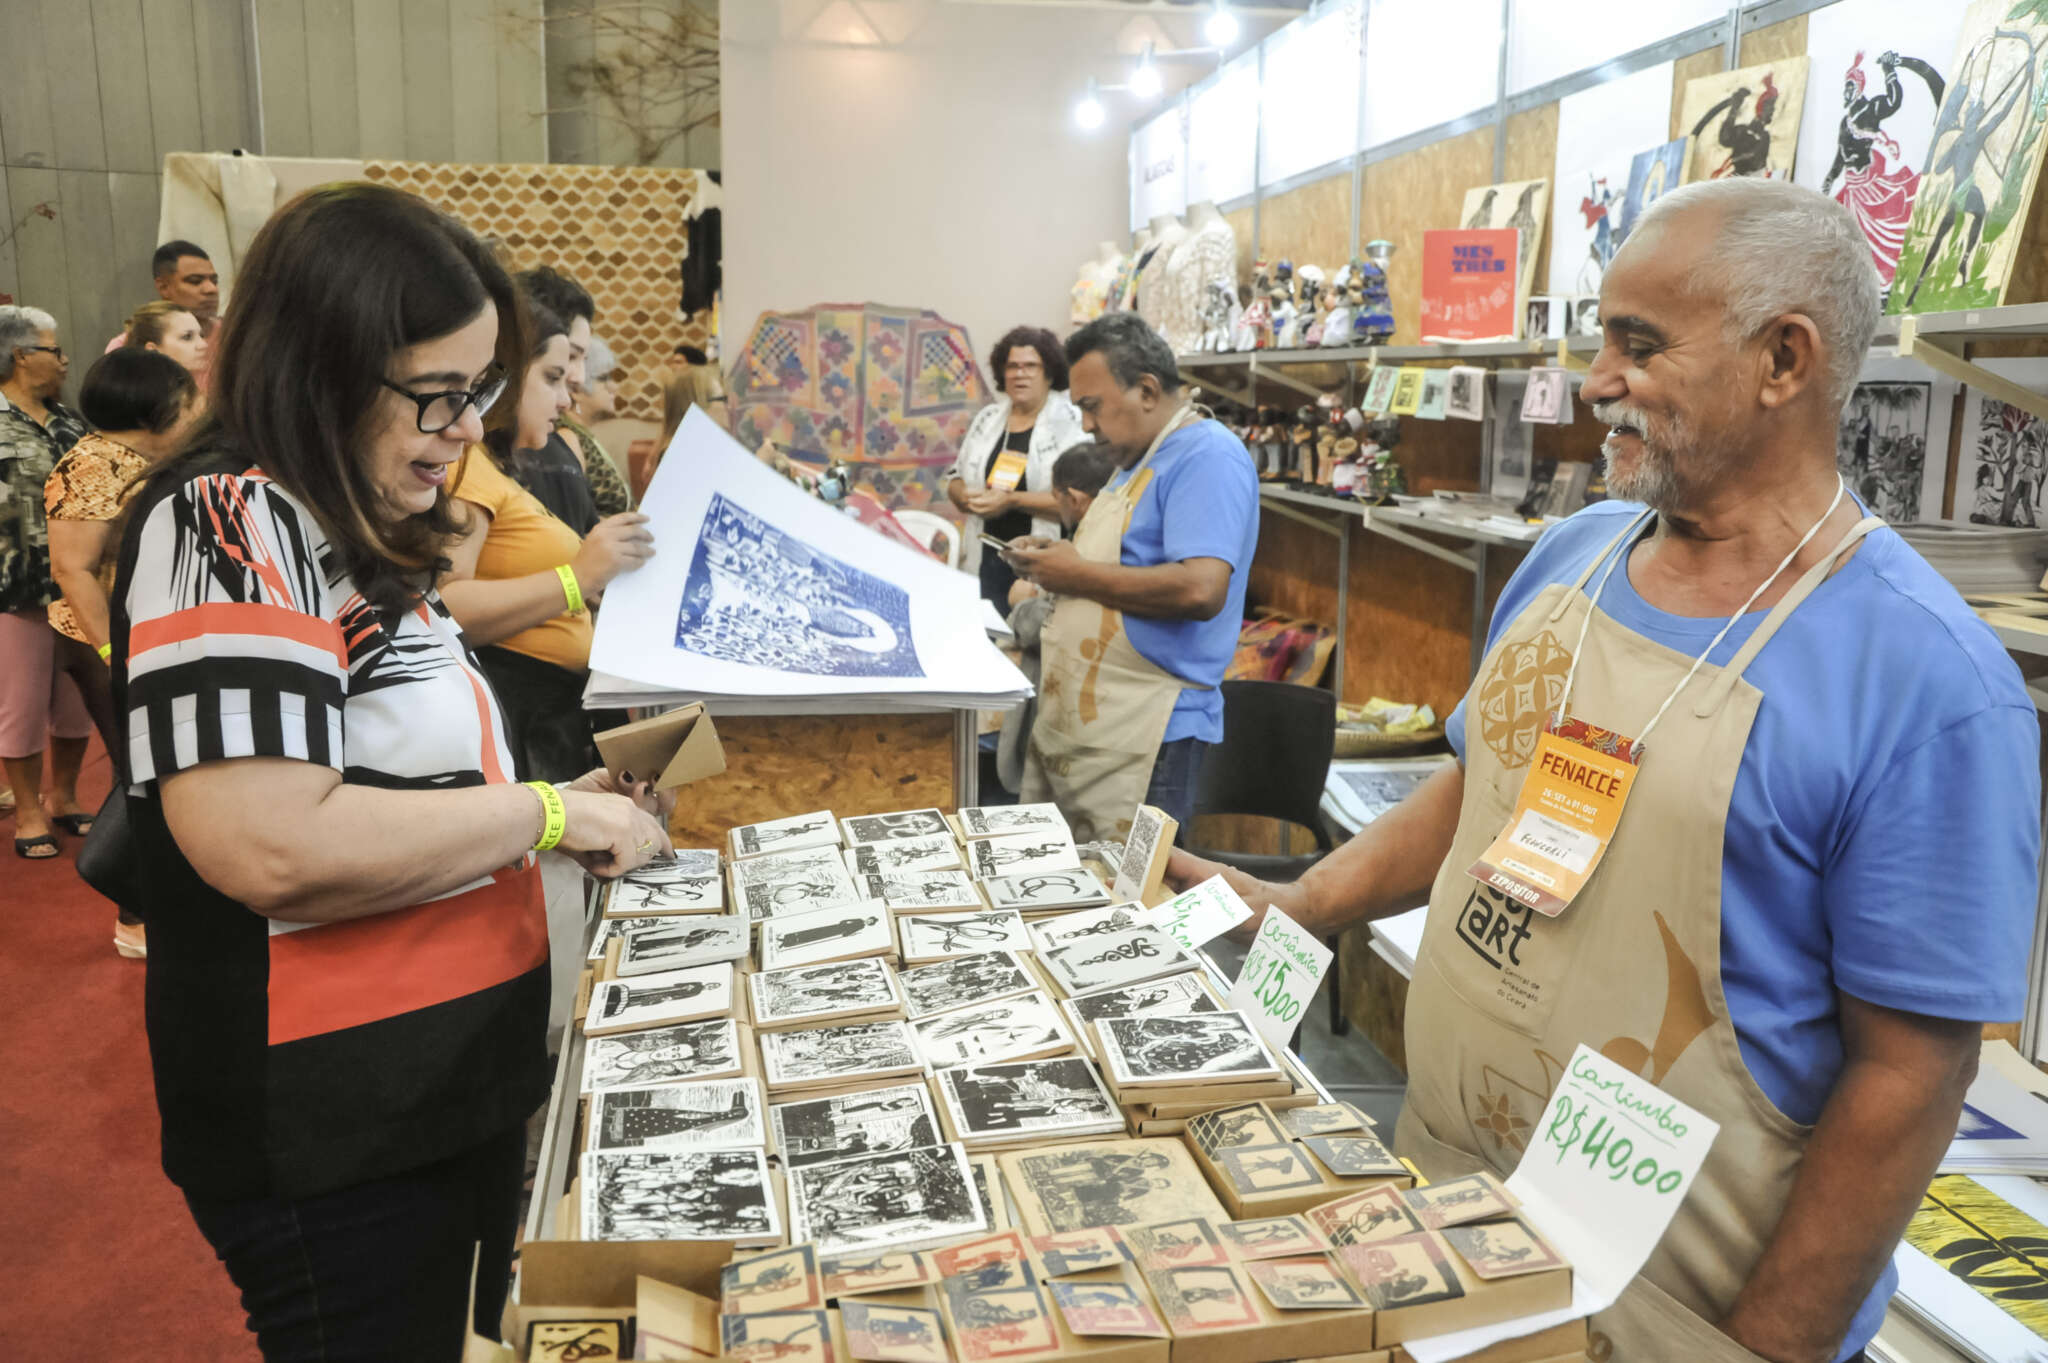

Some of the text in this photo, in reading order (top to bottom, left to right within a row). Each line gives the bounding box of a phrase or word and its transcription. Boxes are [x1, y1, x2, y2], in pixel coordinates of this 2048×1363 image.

[1451, 259, 1505, 273] TRES
[1453, 246, 1494, 258] MES
[1540, 752, 1621, 799] FENACCE
[1488, 872, 1541, 904] EXPOSITOR
[1263, 916, 1320, 979] Cerâmica
[1572, 1055, 1689, 1138] Carimbo
